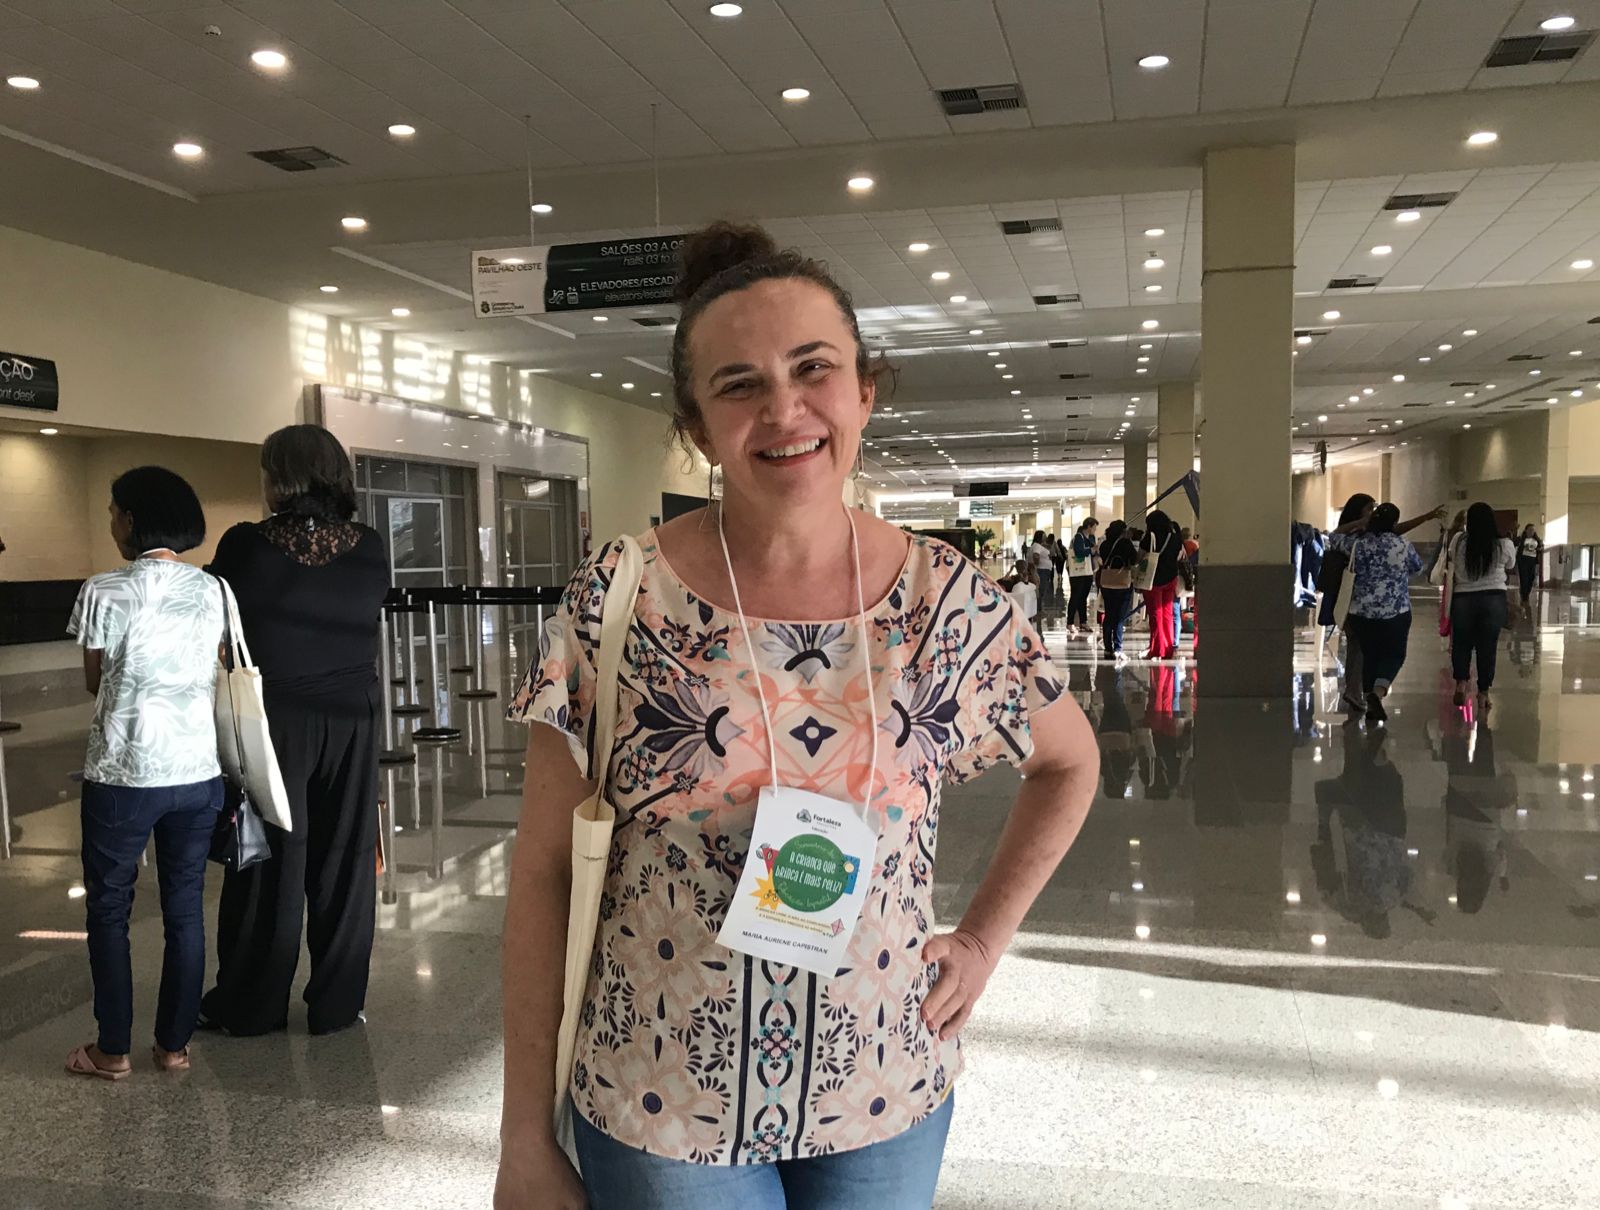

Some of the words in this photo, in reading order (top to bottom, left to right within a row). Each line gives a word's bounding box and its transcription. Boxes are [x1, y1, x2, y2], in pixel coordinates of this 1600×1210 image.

[600, 243, 643, 257] SALÕES
[643, 242, 659, 253] 03
[660, 241, 669, 251] A
[516, 262, 543, 272] OESTE
[13, 388, 36, 403] desk
[813, 813, 842, 828] Fortaleza
[789, 850, 796, 864] A
[742, 930, 763, 941] MARIA
